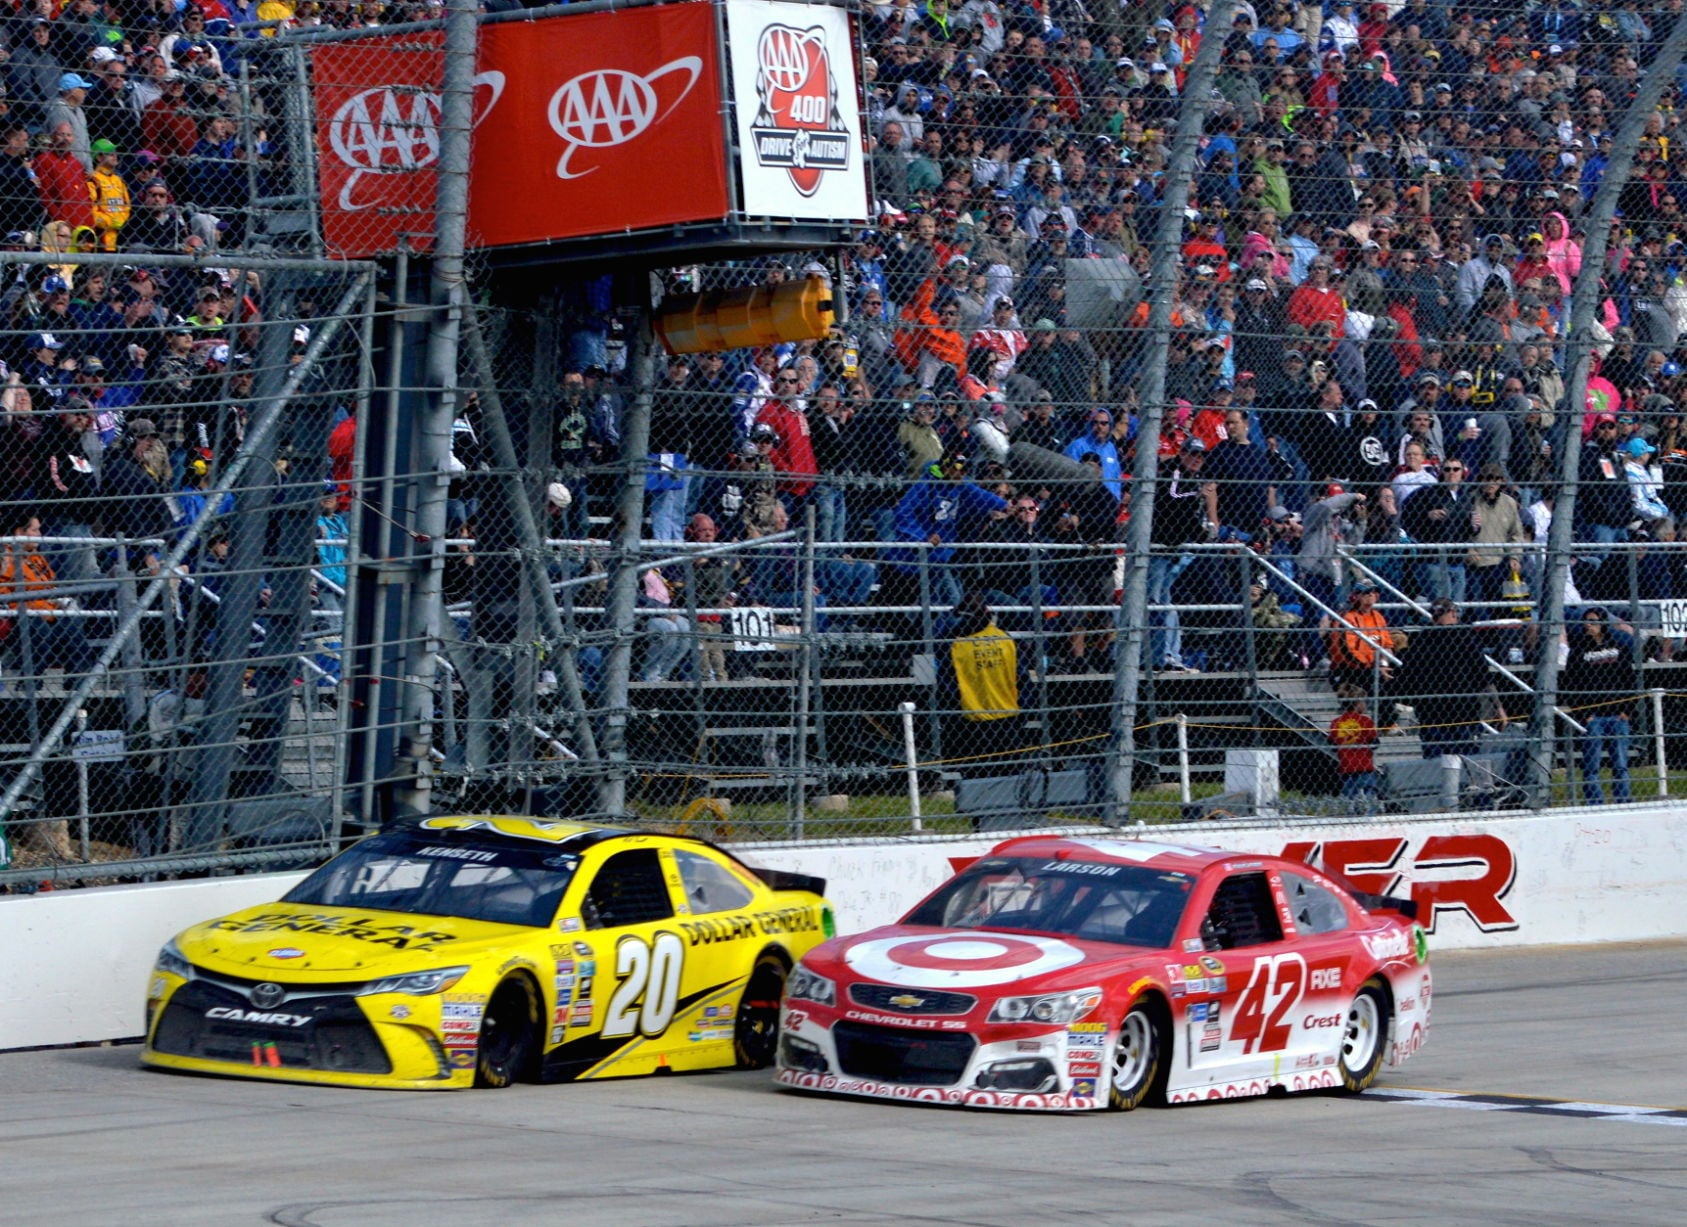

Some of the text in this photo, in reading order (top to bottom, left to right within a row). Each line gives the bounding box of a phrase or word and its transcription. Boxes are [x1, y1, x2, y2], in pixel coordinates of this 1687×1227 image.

[762, 29, 806, 88] AAA
[564, 72, 650, 144] AAA
[790, 95, 826, 123] 400
[347, 89, 440, 168] AAA
[760, 137, 793, 156] DRIVE
[811, 141, 847, 160] AUTISM
[734, 610, 773, 646] 101
[416, 846, 498, 862] KENSETH
[1041, 861, 1122, 876] LARSON
[207, 920, 434, 952] GENERAL
[247, 914, 458, 942] DOLLAR
[679, 905, 819, 946] DOLLAR GENERAL
[600, 929, 685, 1040] 20
[1310, 966, 1341, 990] AXE
[204, 1006, 313, 1027] CAMRY
[1227, 951, 1308, 1056] 42
[784, 1010, 808, 1031] 42
[845, 1010, 967, 1029] CHEVROLET SS
[1303, 1012, 1342, 1030] Crest
